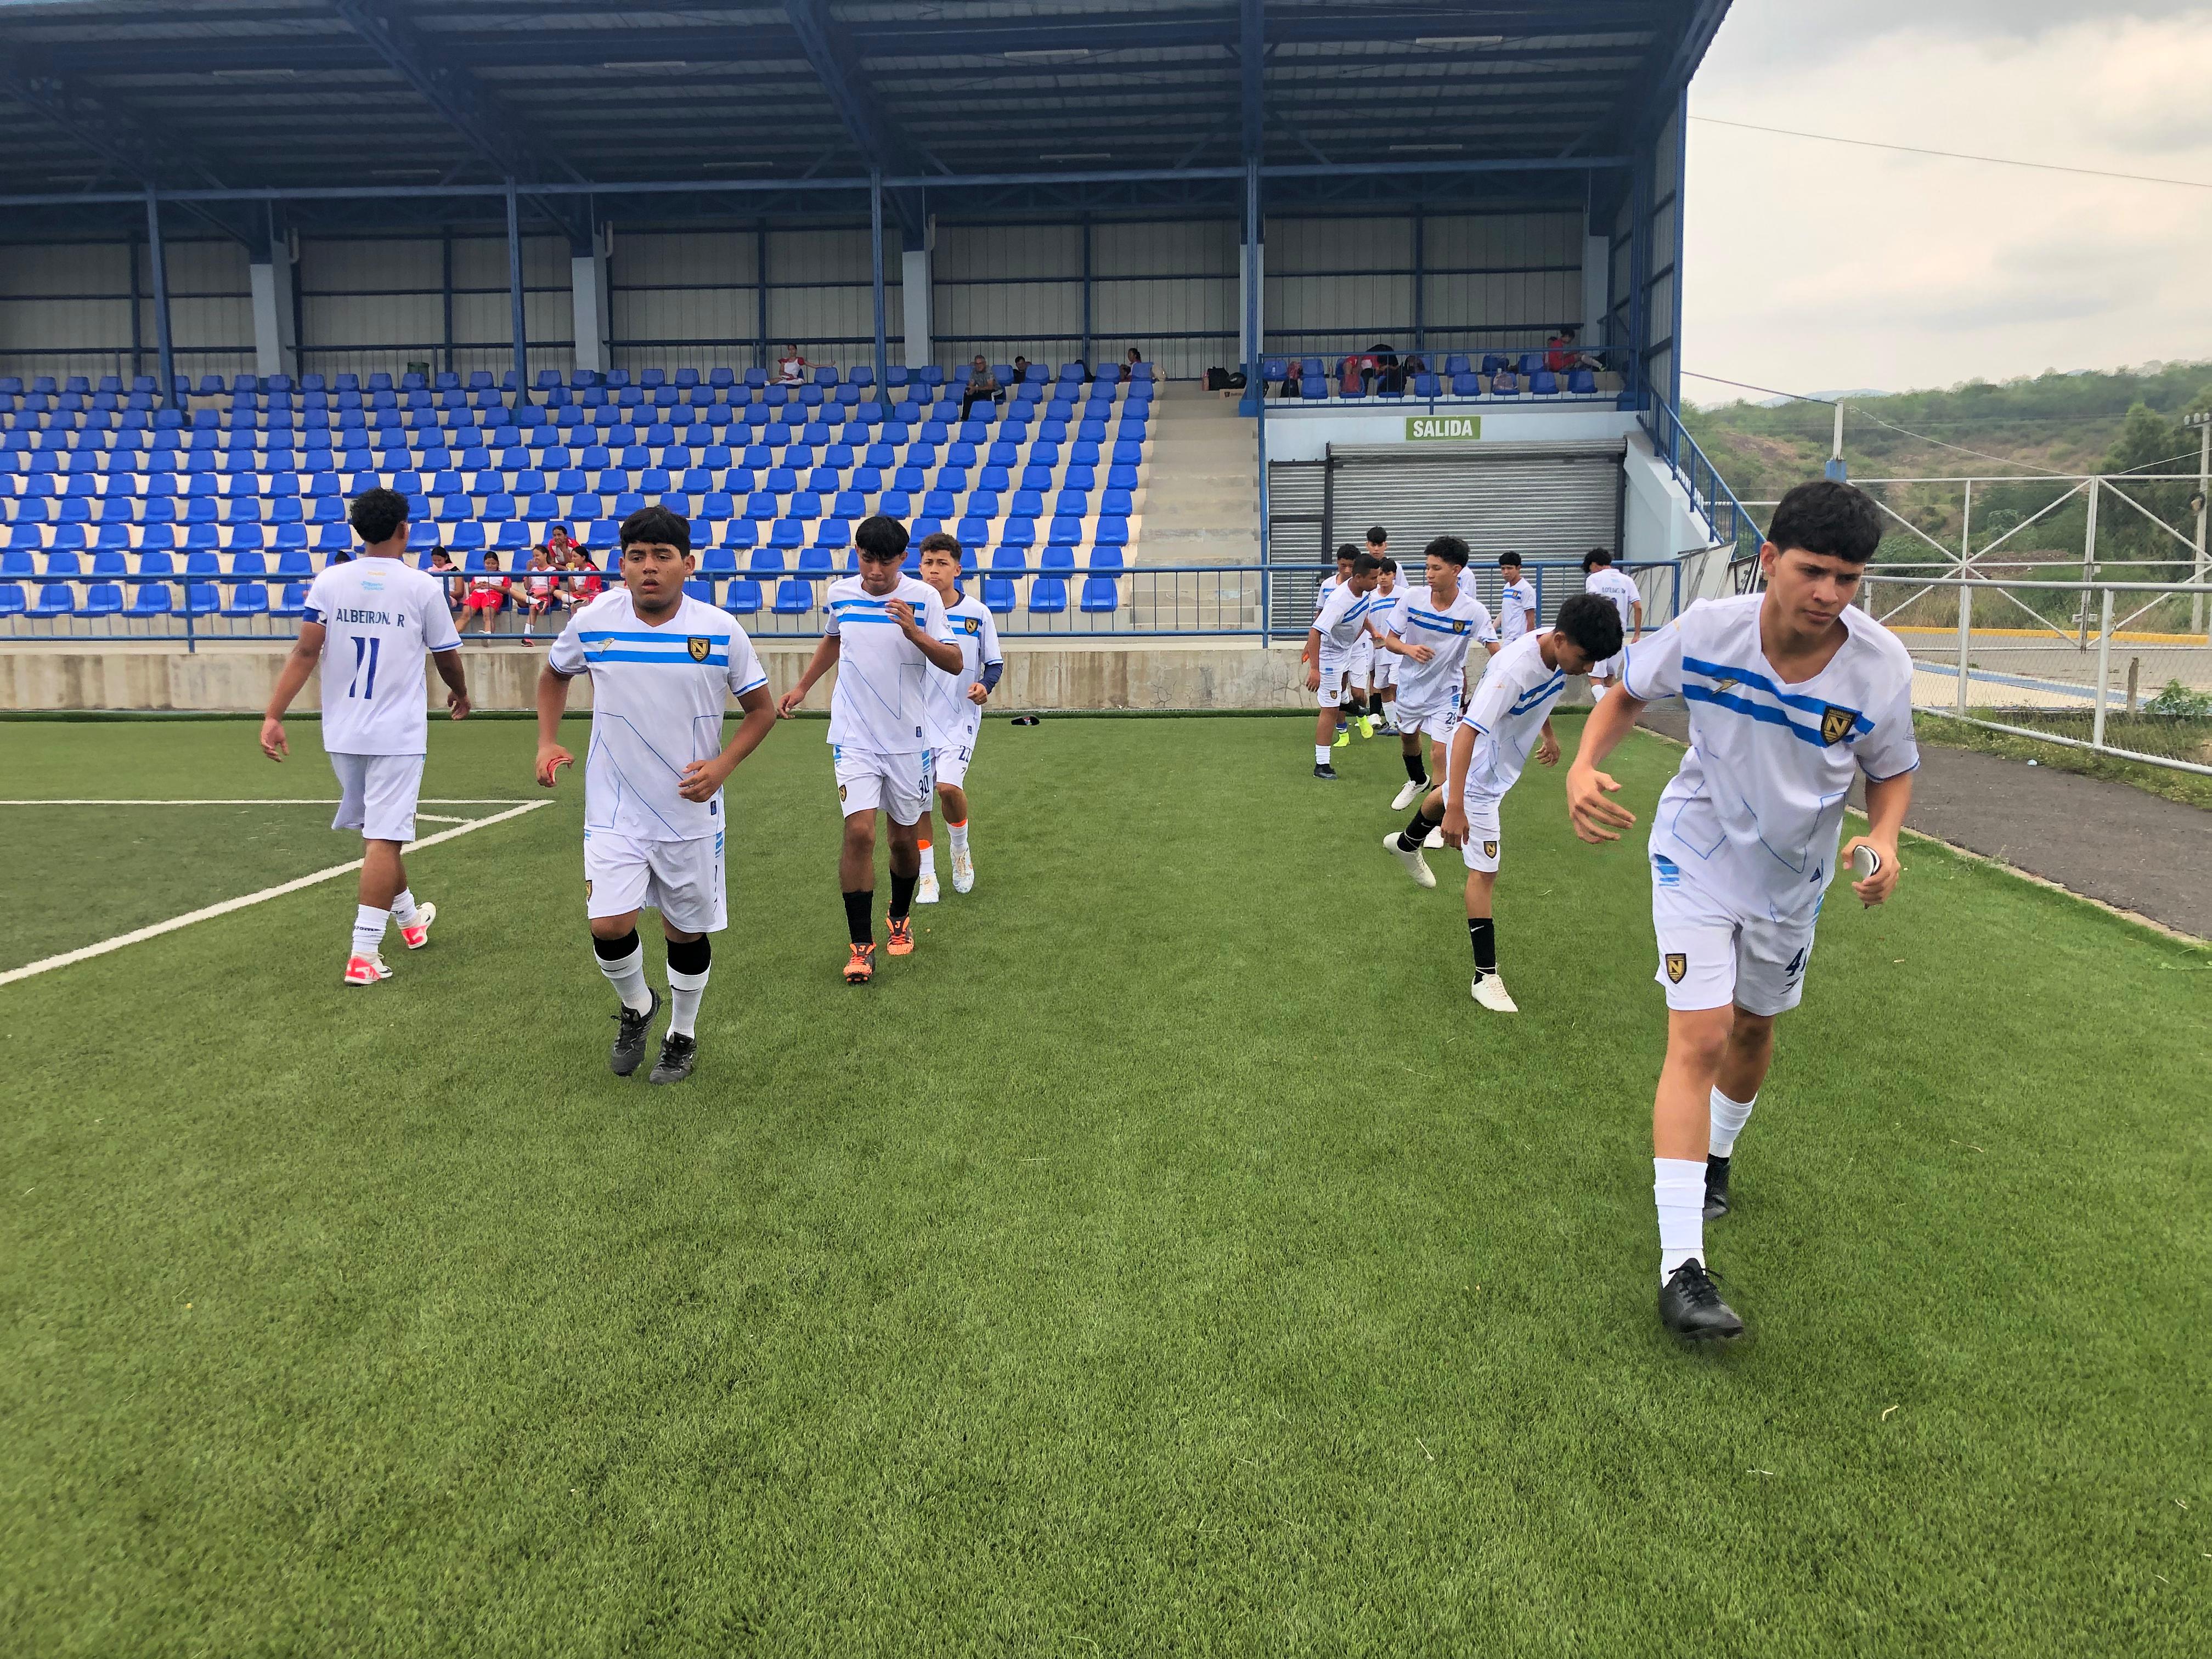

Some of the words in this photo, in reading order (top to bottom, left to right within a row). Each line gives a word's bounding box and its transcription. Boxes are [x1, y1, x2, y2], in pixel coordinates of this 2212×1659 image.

[1413, 420, 1473, 437] SALIDA
[397, 614, 405, 627] R
[966, 621, 976, 630] N
[692, 642, 707, 655] N
[349, 636, 380, 699] 11
[1825, 715, 1849, 736] N
[918, 775, 930, 799] 30
[1668, 960, 1683, 975] N
